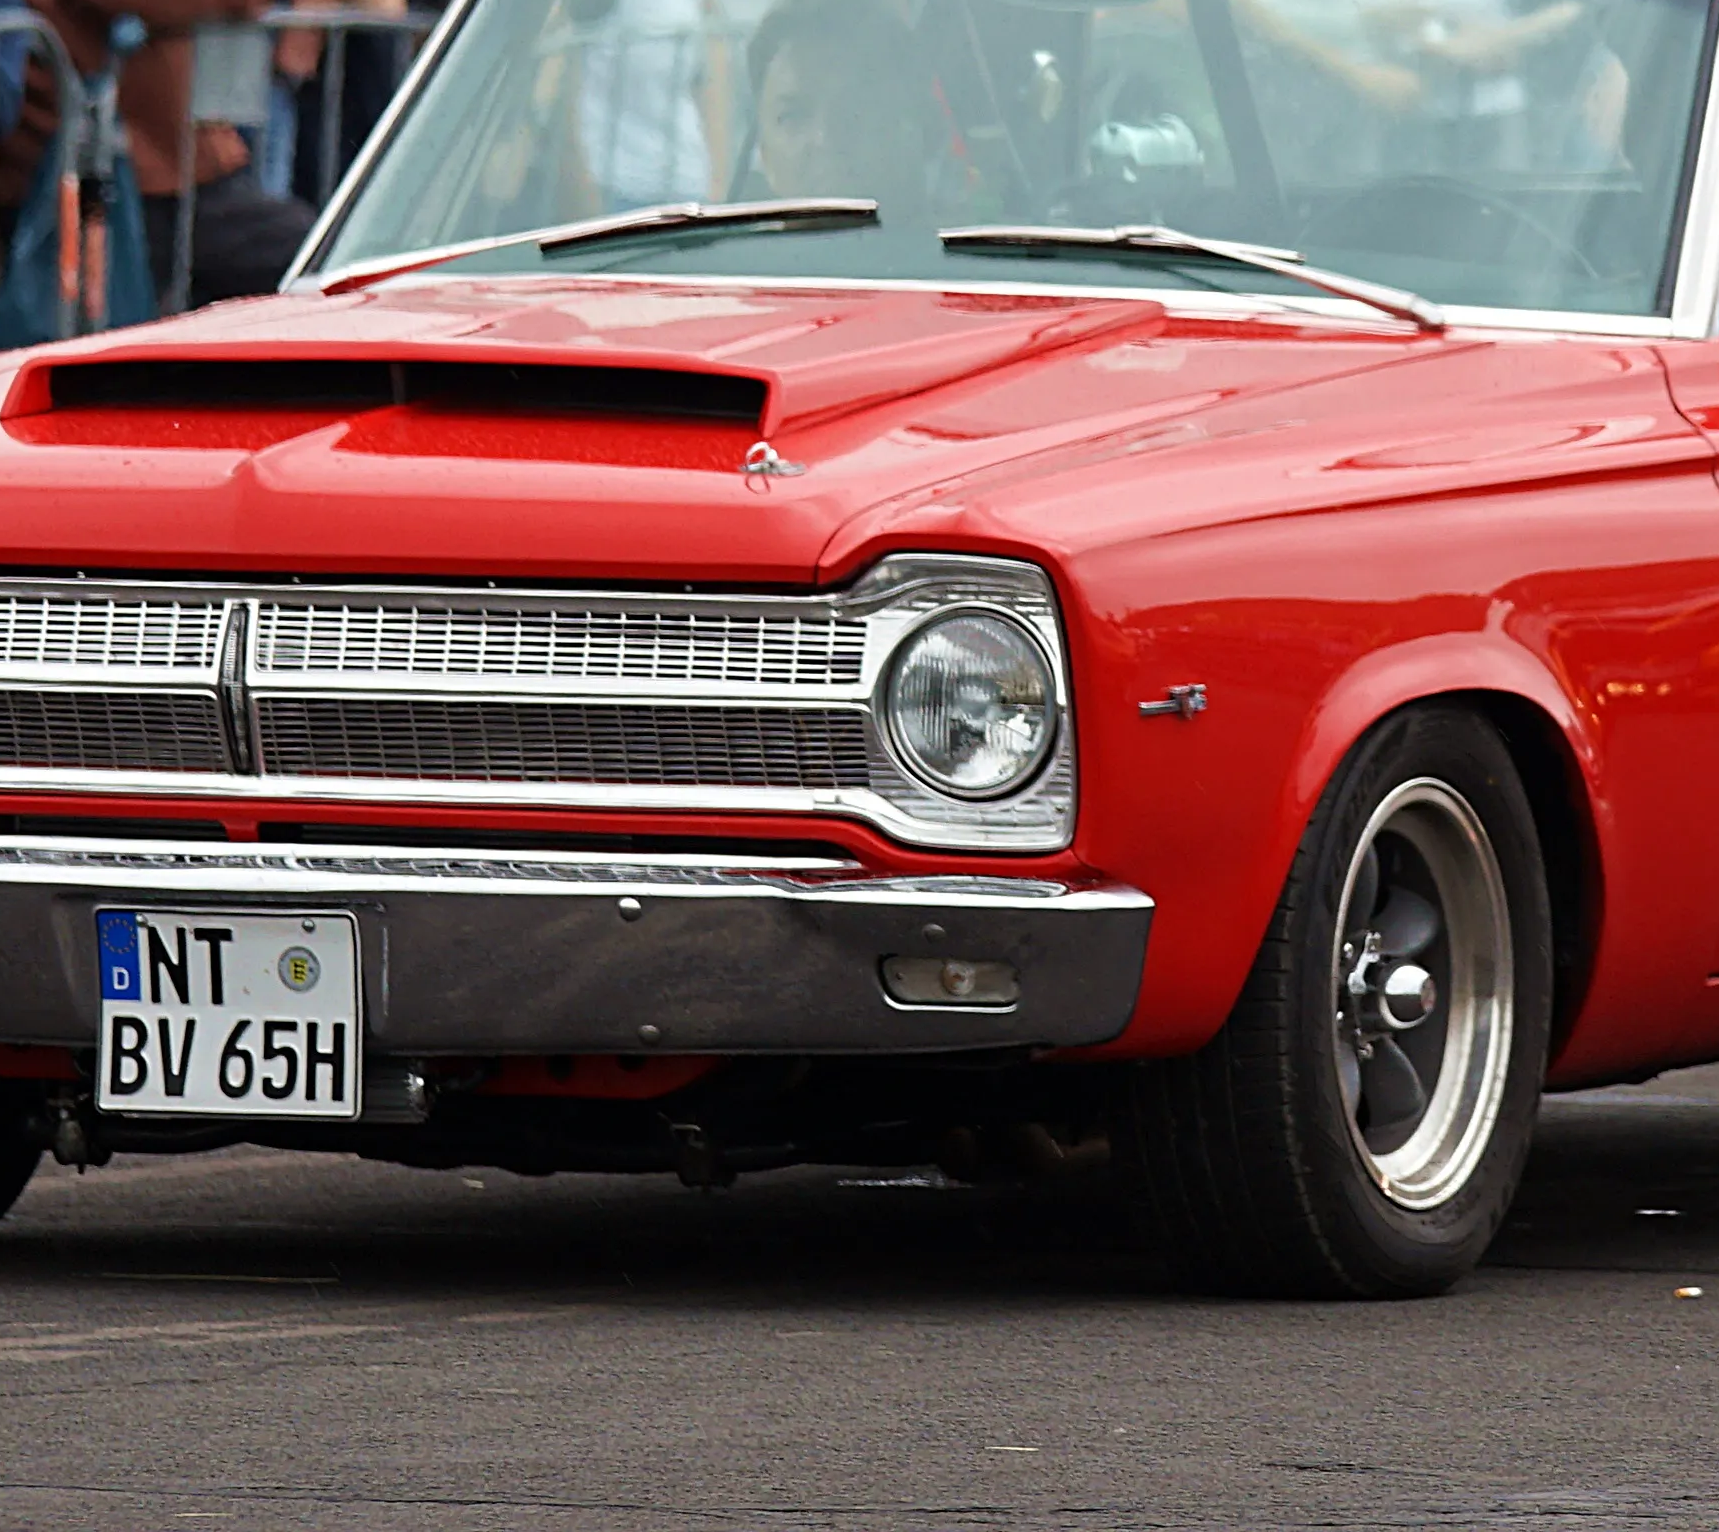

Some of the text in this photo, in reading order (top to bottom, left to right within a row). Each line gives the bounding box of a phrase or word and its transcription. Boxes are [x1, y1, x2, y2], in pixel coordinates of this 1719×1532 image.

[112, 967, 130, 991] D
[147, 926, 234, 1005] NT
[110, 1016, 346, 1103] BV 65H
